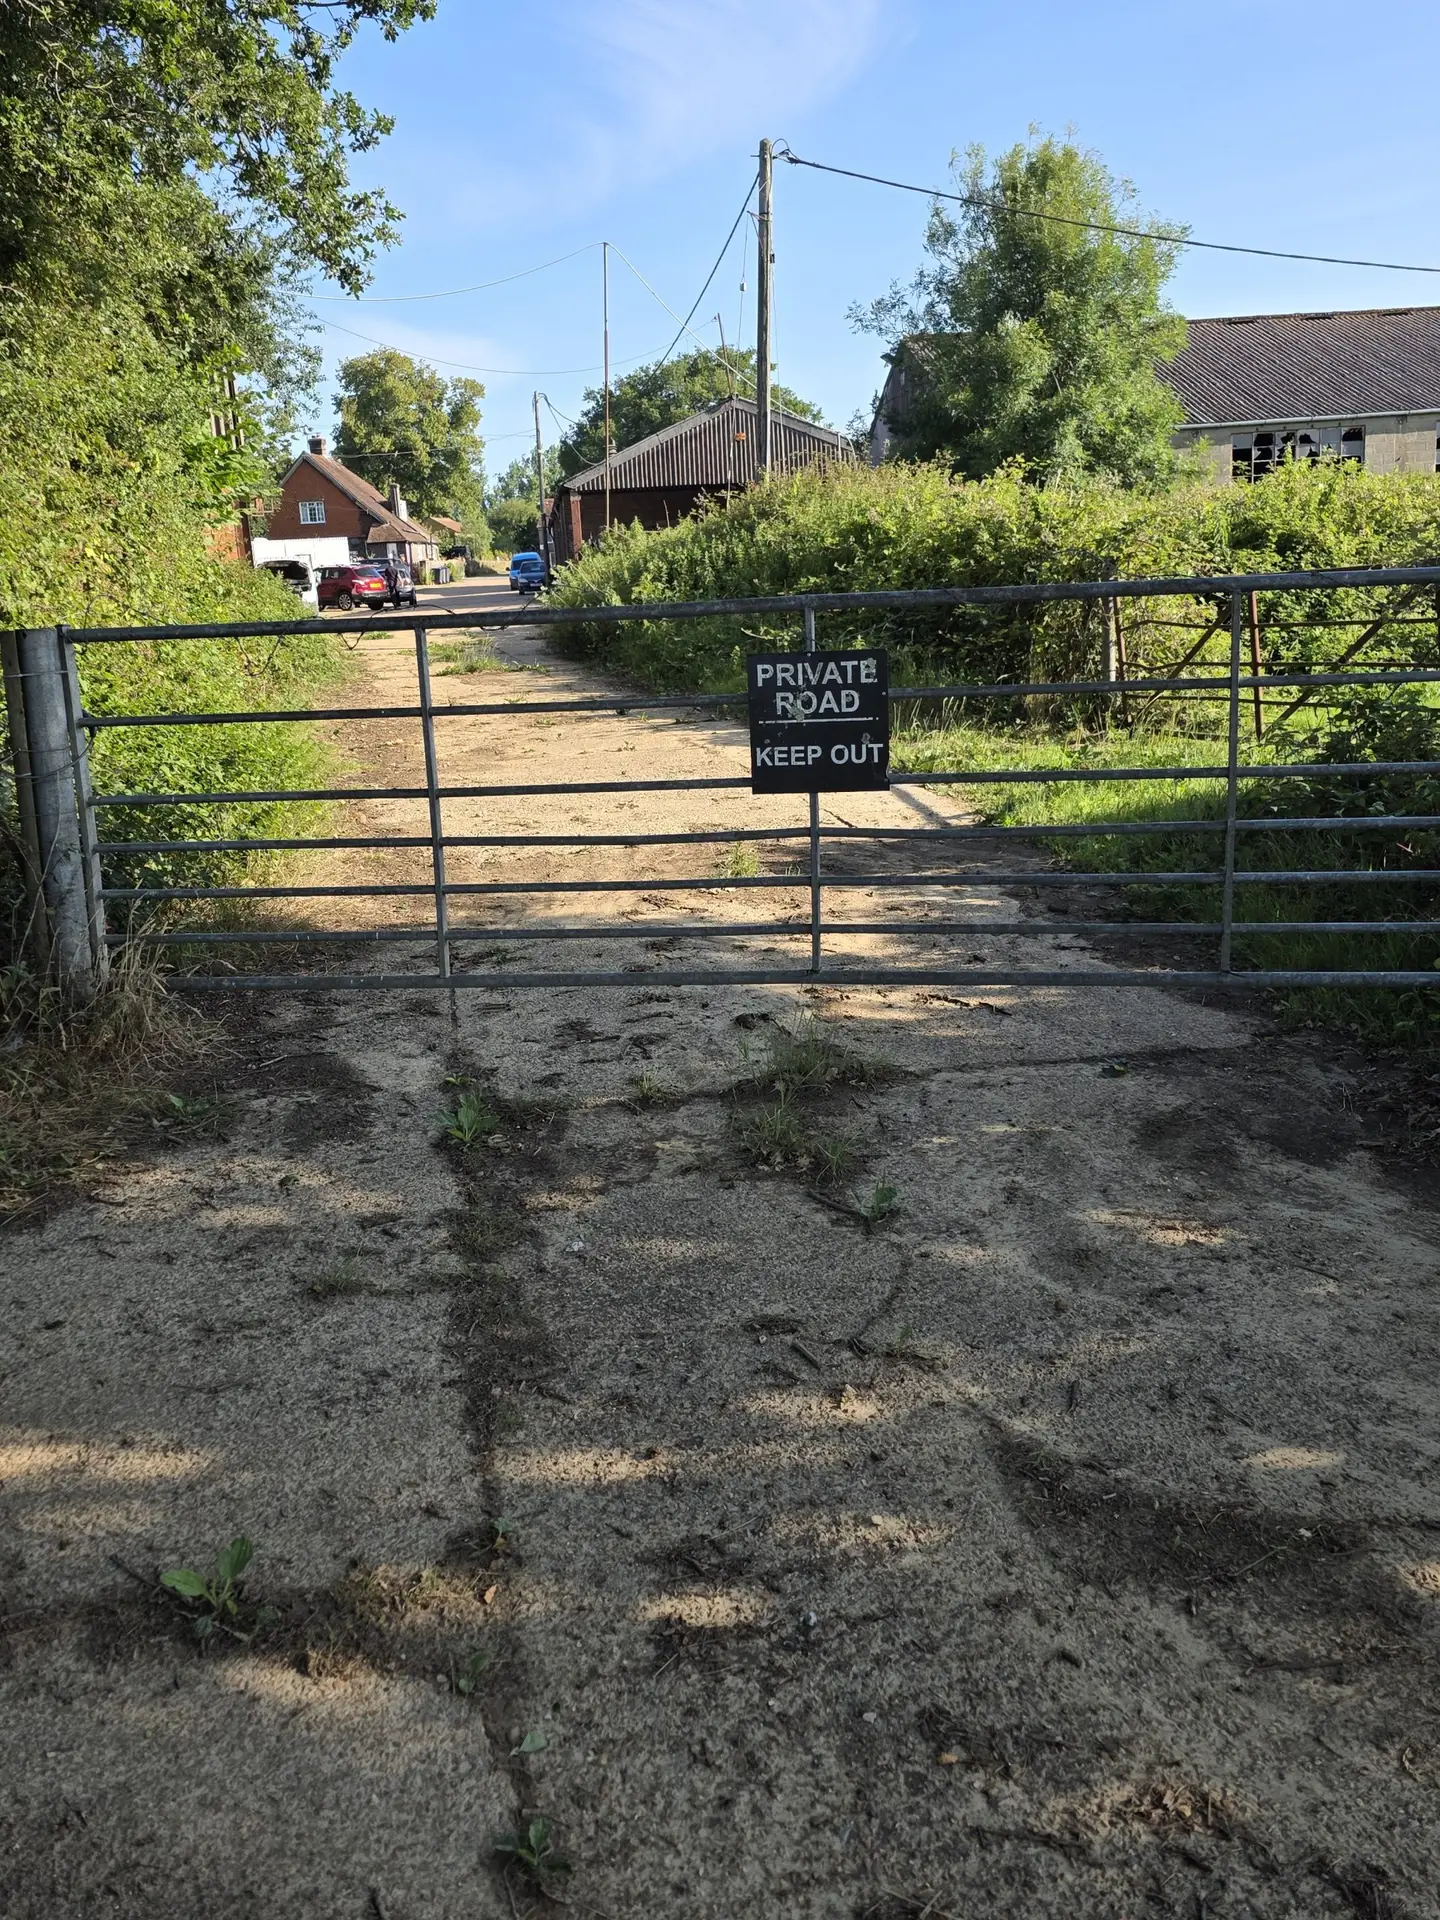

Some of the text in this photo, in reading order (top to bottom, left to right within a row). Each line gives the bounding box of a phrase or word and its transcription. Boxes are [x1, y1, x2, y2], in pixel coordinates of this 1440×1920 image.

[756, 659, 878, 687] PRIVATE
[775, 689, 860, 715] ROAD
[756, 743, 884, 767] KEEP OUT
